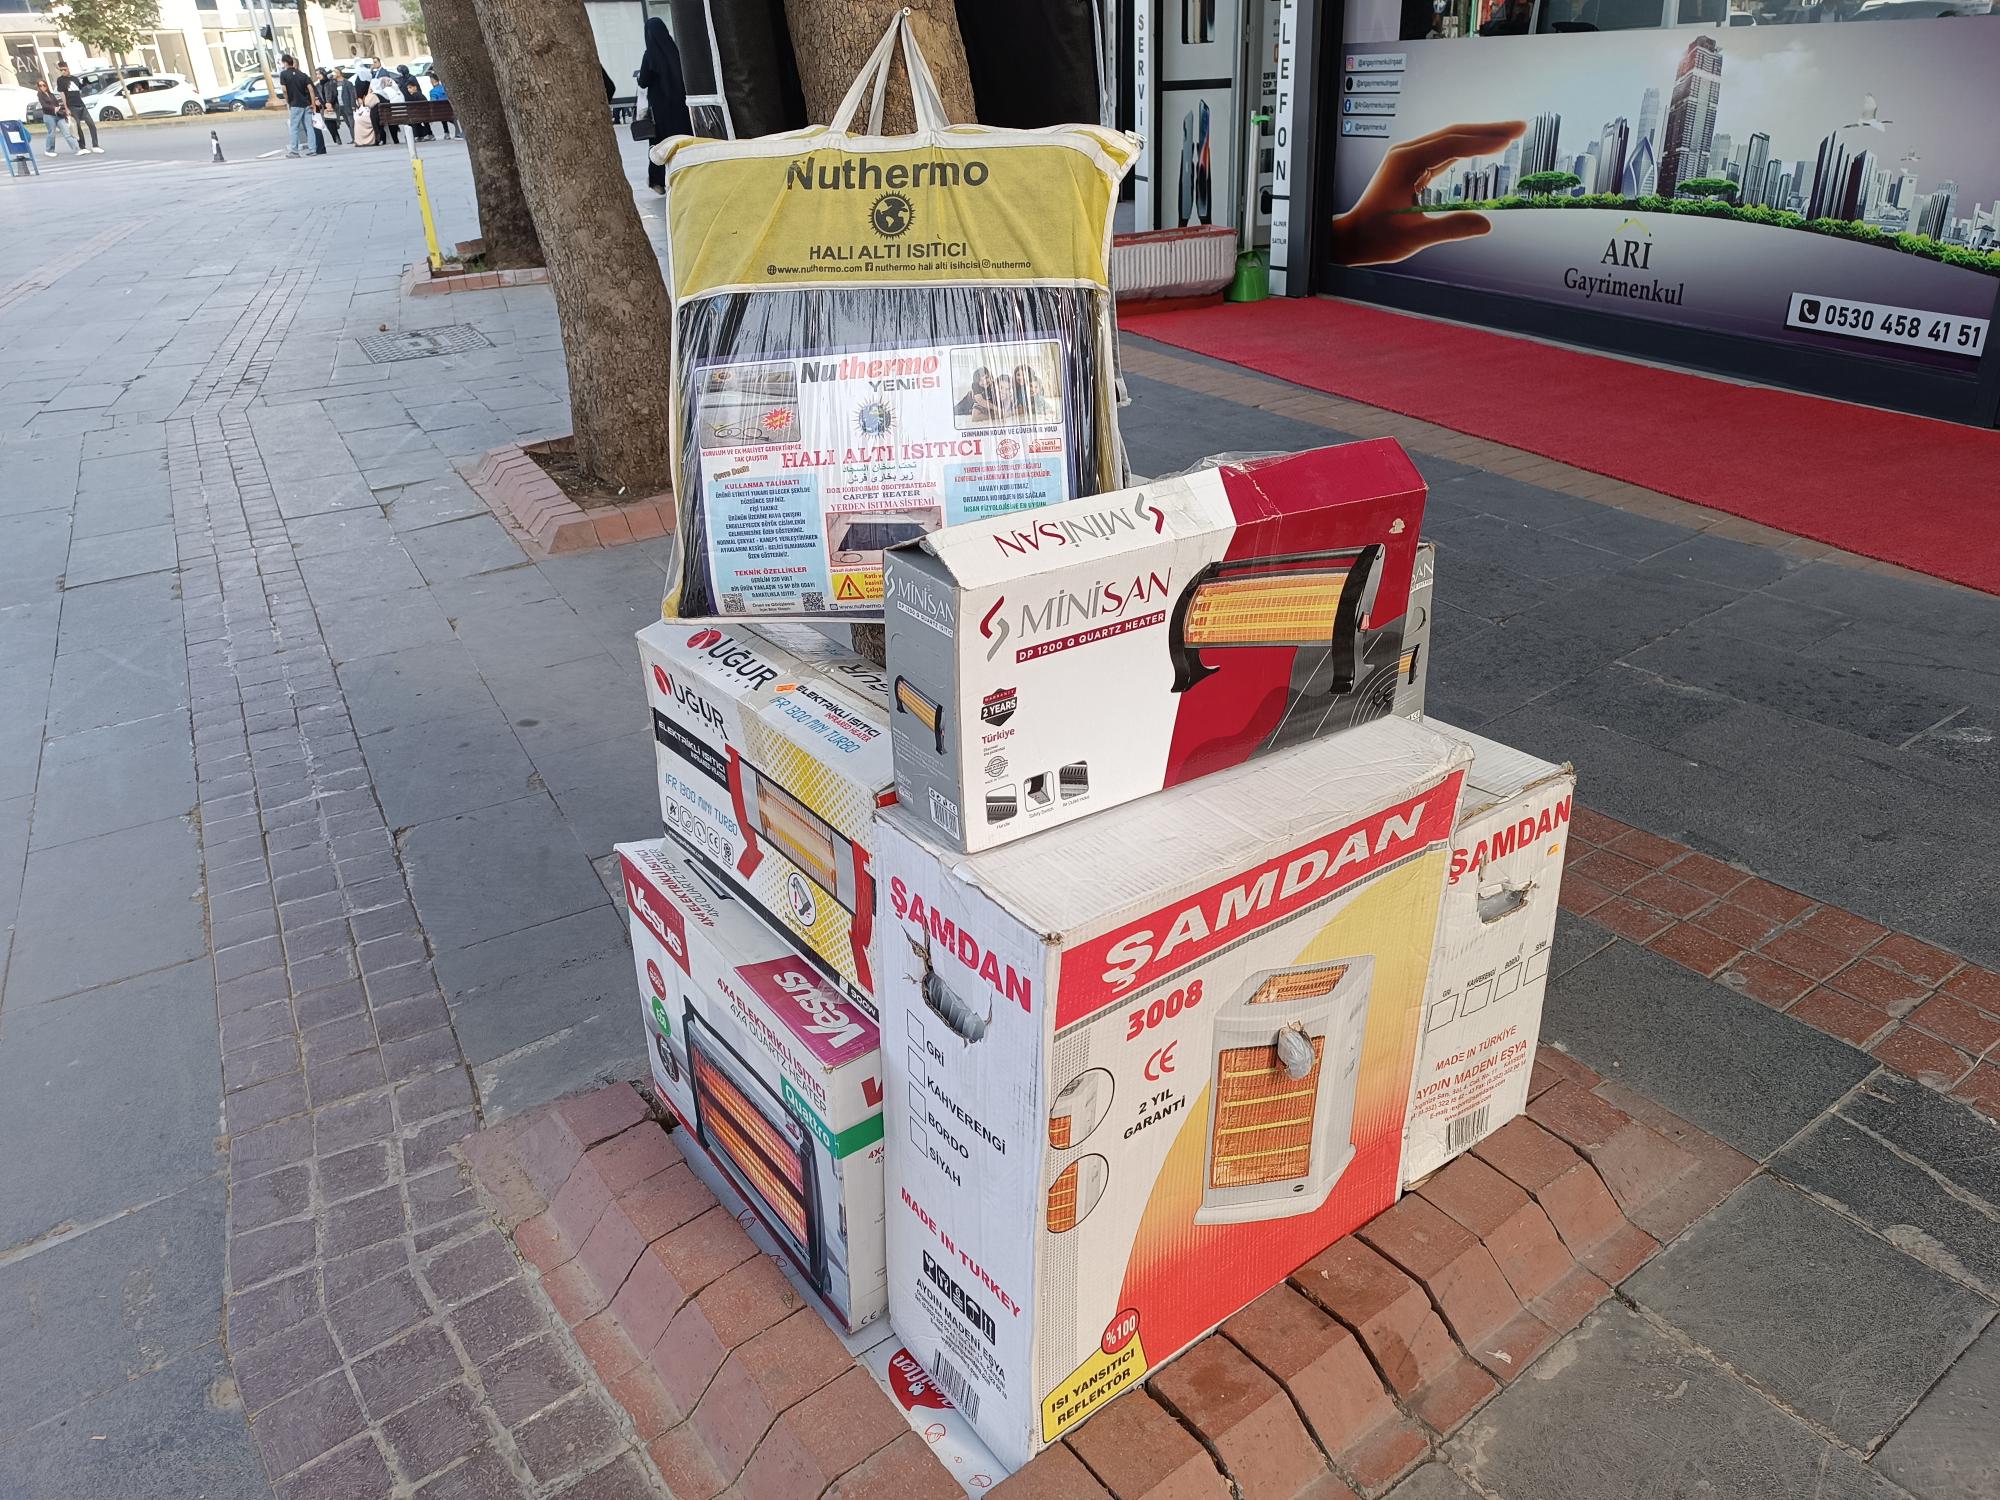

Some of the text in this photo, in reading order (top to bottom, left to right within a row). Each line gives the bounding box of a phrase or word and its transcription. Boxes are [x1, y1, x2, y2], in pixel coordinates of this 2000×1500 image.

[786, 155, 989, 191] Nuthermo
[777, 263, 863, 274] www.nuthermo.com
[875, 261, 916, 272] nuthermo
[918, 260, 933, 271] hali
[935, 260, 948, 270] alti
[991, 259, 1032, 270] nuthermo
[809, 245, 853, 260] HALI
[857, 244, 901, 259] ALTI
[1600, 233, 1654, 270] ARİ
[1564, 267, 1685, 307] Gayrimenkul
[1824, 304, 1981, 348] 0530 458 41 51
[800, 355, 940, 384] Nuthermo
[781, 449, 835, 468] HALI
[843, 446, 895, 464] ALTI
[902, 440, 983, 460] ISITICI
[724, 479, 800, 490] KULLANMA TALİMATI
[830, 496, 935, 511] YERDEN ISITMA SİSTEMİ
[842, 489, 921, 500] CARPET HEATER
[993, 508, 1136, 558] MİNİSAN
[734, 566, 807, 576] TEKNİK ÖZELLİKLER
[1018, 567, 1173, 638] MİNİSAN
[1019, 612, 1165, 662] DP 1200 Q QUARTZ HEATER
[707, 637, 778, 692] UĞUR
[668, 671, 729, 741] UĞUR
[796, 684, 882, 739] ELEKTRİKLİ ISITICI
[824, 711, 872, 744] INFRARED HEATER
[982, 698, 1016, 718] 2 YEARS
[658, 720, 701, 756] ELEKTRİKLİ
[824, 728, 862, 754] TURBO
[981, 727, 1016, 744] Türkiye
[713, 807, 738, 837] TURBO
[1449, 794, 1573, 885] ŞAMDAN
[672, 874, 708, 904] QUARTZ
[1101, 801, 1426, 993] ŞAMDAN
[628, 880, 682, 957] Vesus
[890, 875, 1032, 1014] ŞAMDAN
[772, 970, 866, 1049] Vesus
[1125, 979, 1203, 1042] 3008
[717, 977, 735, 1003] 4X4
[734, 998, 793, 1064] ELEKTRİKLİ
[793, 1059, 826, 1101] ISITICI
[730, 1002, 828, 1117] 4X4 QUARTZ HEATER
[926, 1040, 945, 1068] GRİ
[1143, 1039, 1178, 1082] CE
[1435, 1024, 1518, 1072] MADE IN TÜRKİYE
[1416, 1039, 1528, 1100] AYDIN MADENİ EŞYA
[785, 1083, 831, 1148] Quattro
[927, 1075, 1006, 1156] KAHVERENGİ
[1123, 1094, 1186, 1140] GARANTİ
[1138, 1088, 1174, 1115] 2 YIL
[927, 1111, 970, 1160] BORDO
[929, 1147, 962, 1187] SİYAH
[901, 1185, 938, 1236] MADE
[940, 1229, 957, 1256] IN
[958, 1248, 1021, 1319] TURKEY
[916, 1278, 942, 1311] AYDIN
[944, 1306, 981, 1351] MADENİ
[982, 1346, 1006, 1381] EŞYA
[1105, 1314, 1137, 1348] %100
[1051, 1347, 1135, 1414] ISI YANSITICI
[1057, 1367, 1131, 1426] REFLEKTÖR
